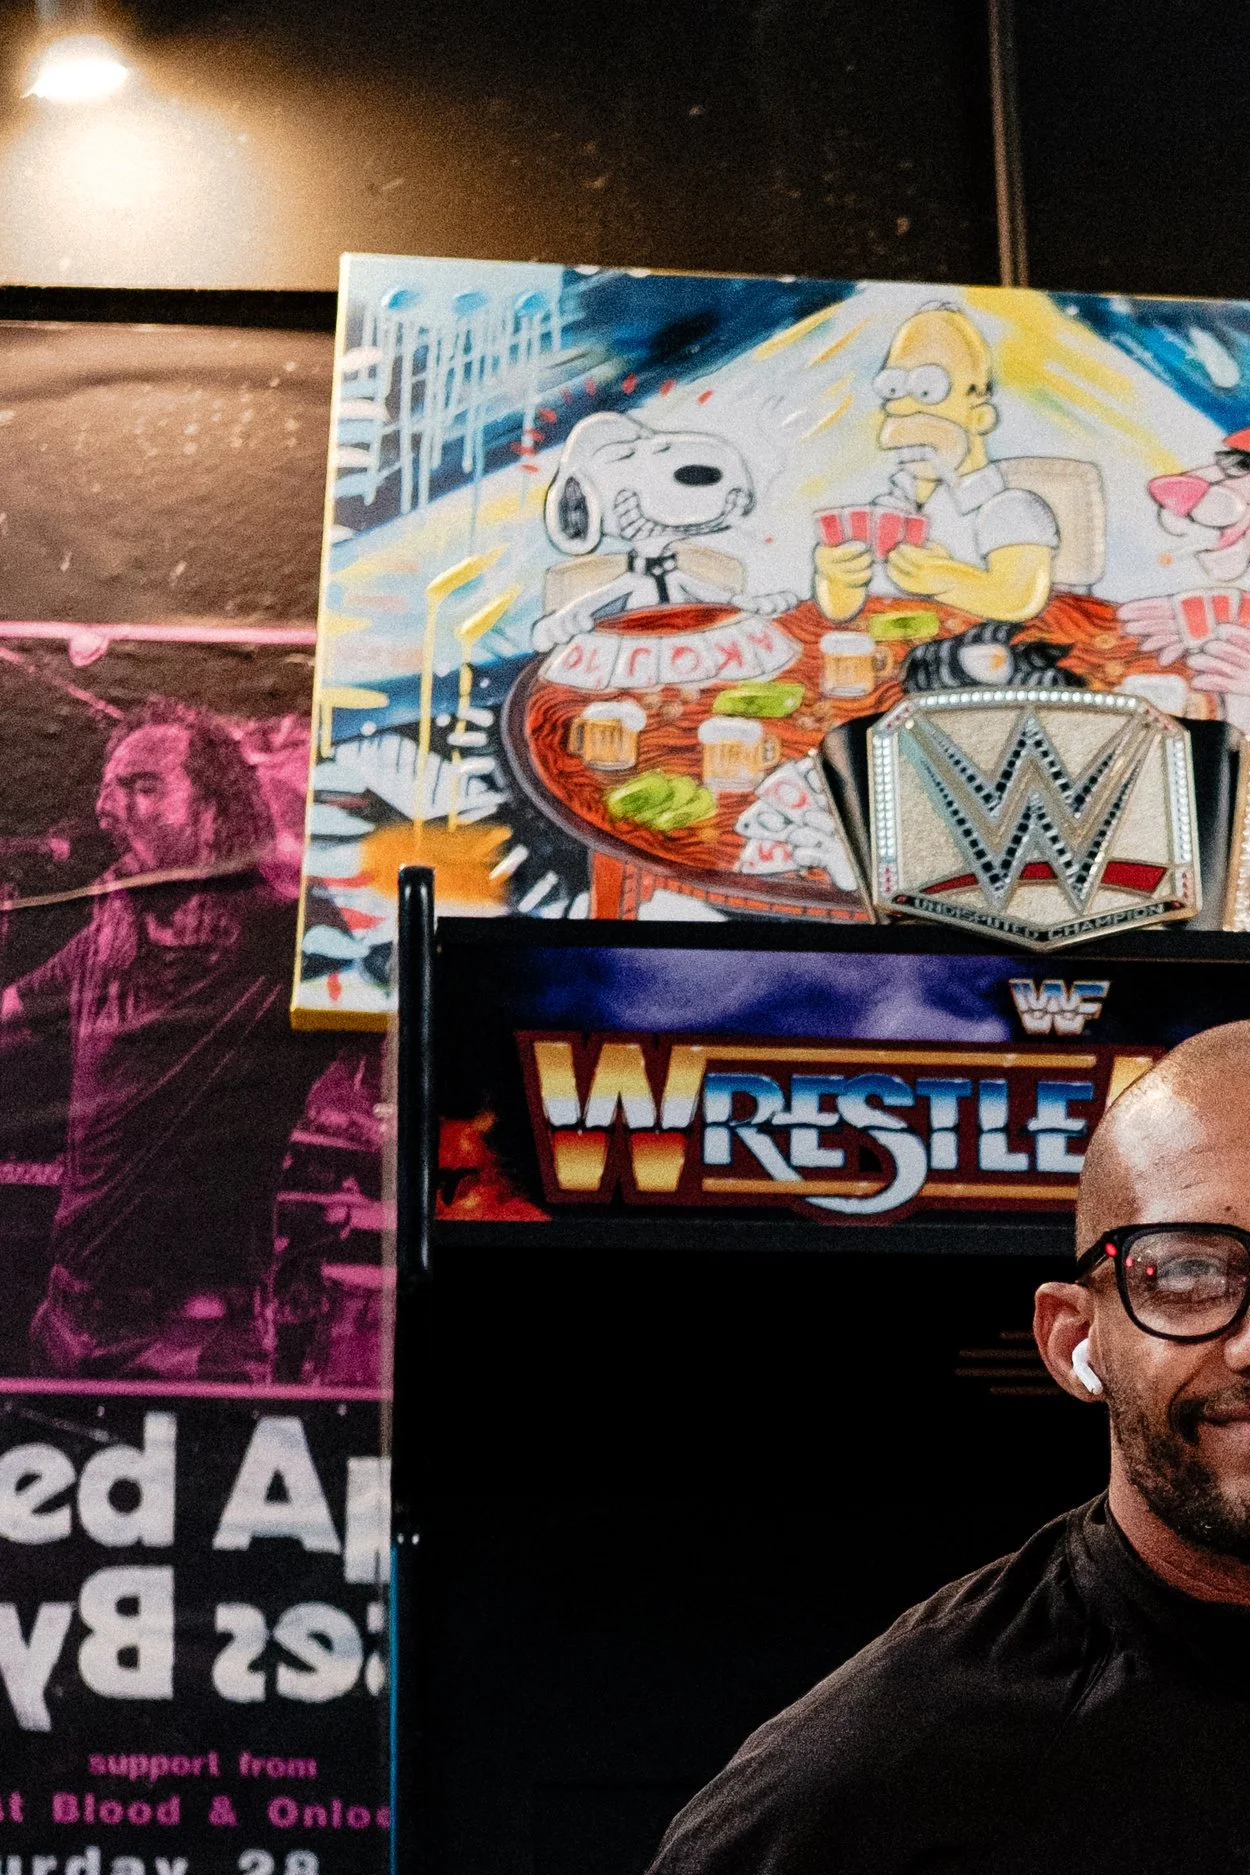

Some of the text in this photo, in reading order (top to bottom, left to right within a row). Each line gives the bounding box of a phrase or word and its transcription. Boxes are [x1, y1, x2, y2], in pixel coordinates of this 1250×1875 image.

[913, 899, 1165, 940] UNDISPUTED CHAMPION
[1009, 978, 1111, 1036] WWF
[89, 1751, 319, 1785] support from
[52, 1792, 182, 1826] Blood
[208, 1795, 239, 1828] &
